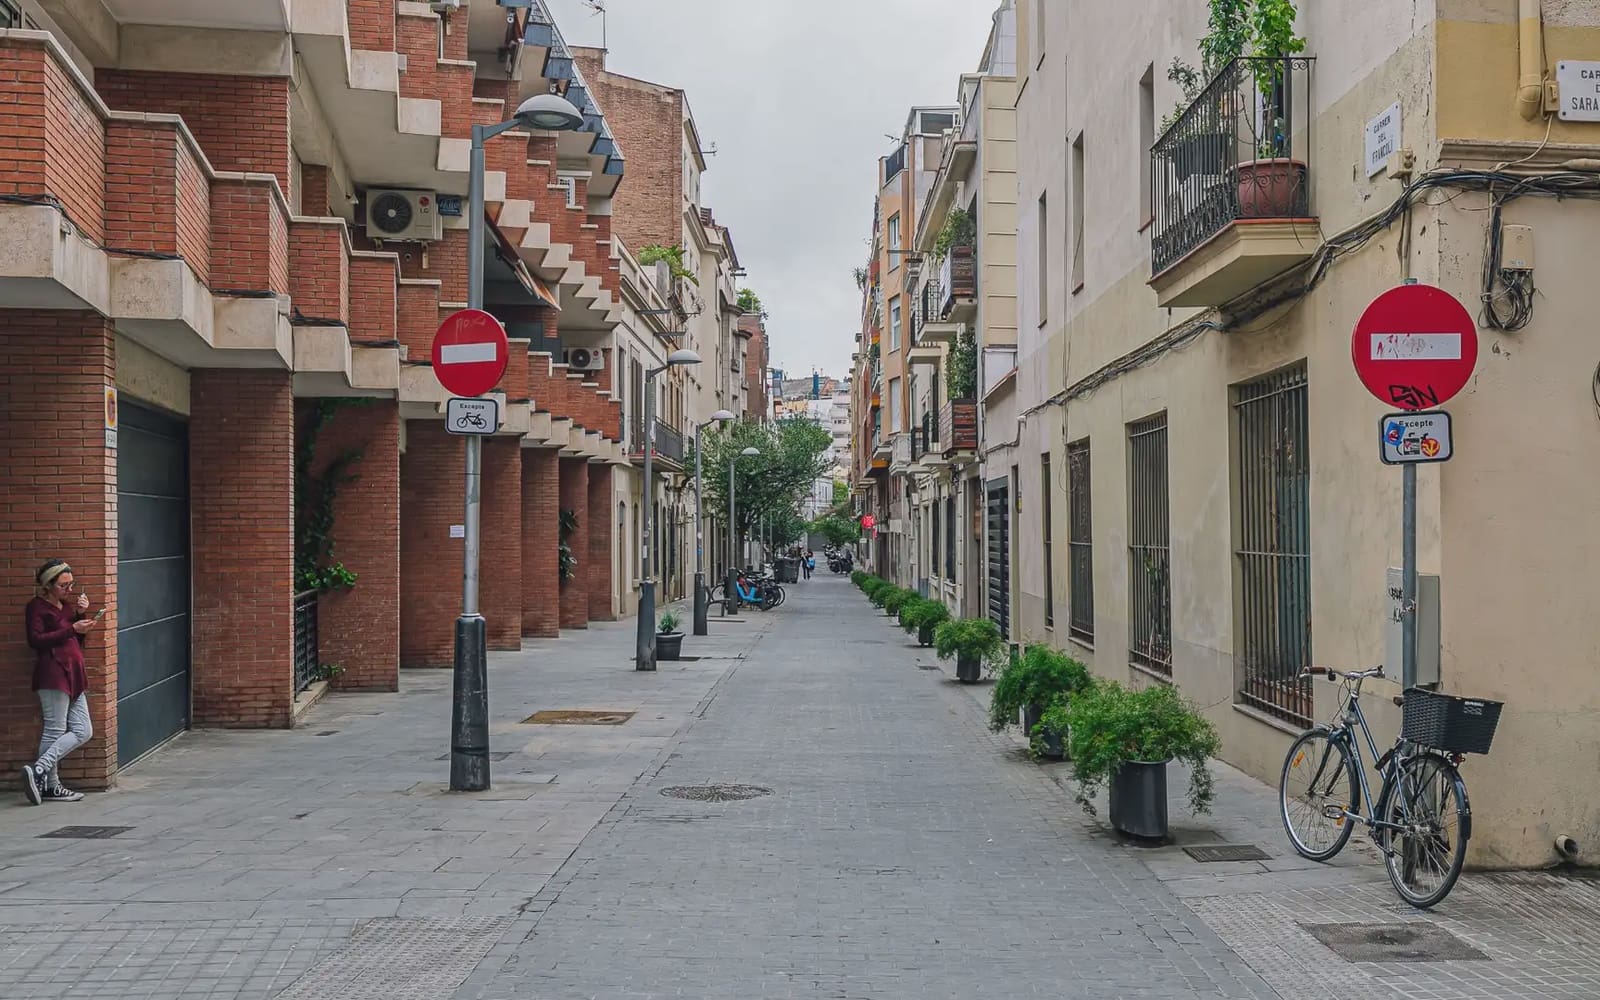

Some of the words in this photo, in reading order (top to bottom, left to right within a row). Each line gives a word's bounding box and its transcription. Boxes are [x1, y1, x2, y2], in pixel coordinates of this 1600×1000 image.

[1572, 97, 1599, 110] SARA
[1373, 115, 1391, 134] CARRER
[1378, 132, 1386, 144] DEL
[1399, 420, 1434, 428] Excepte
